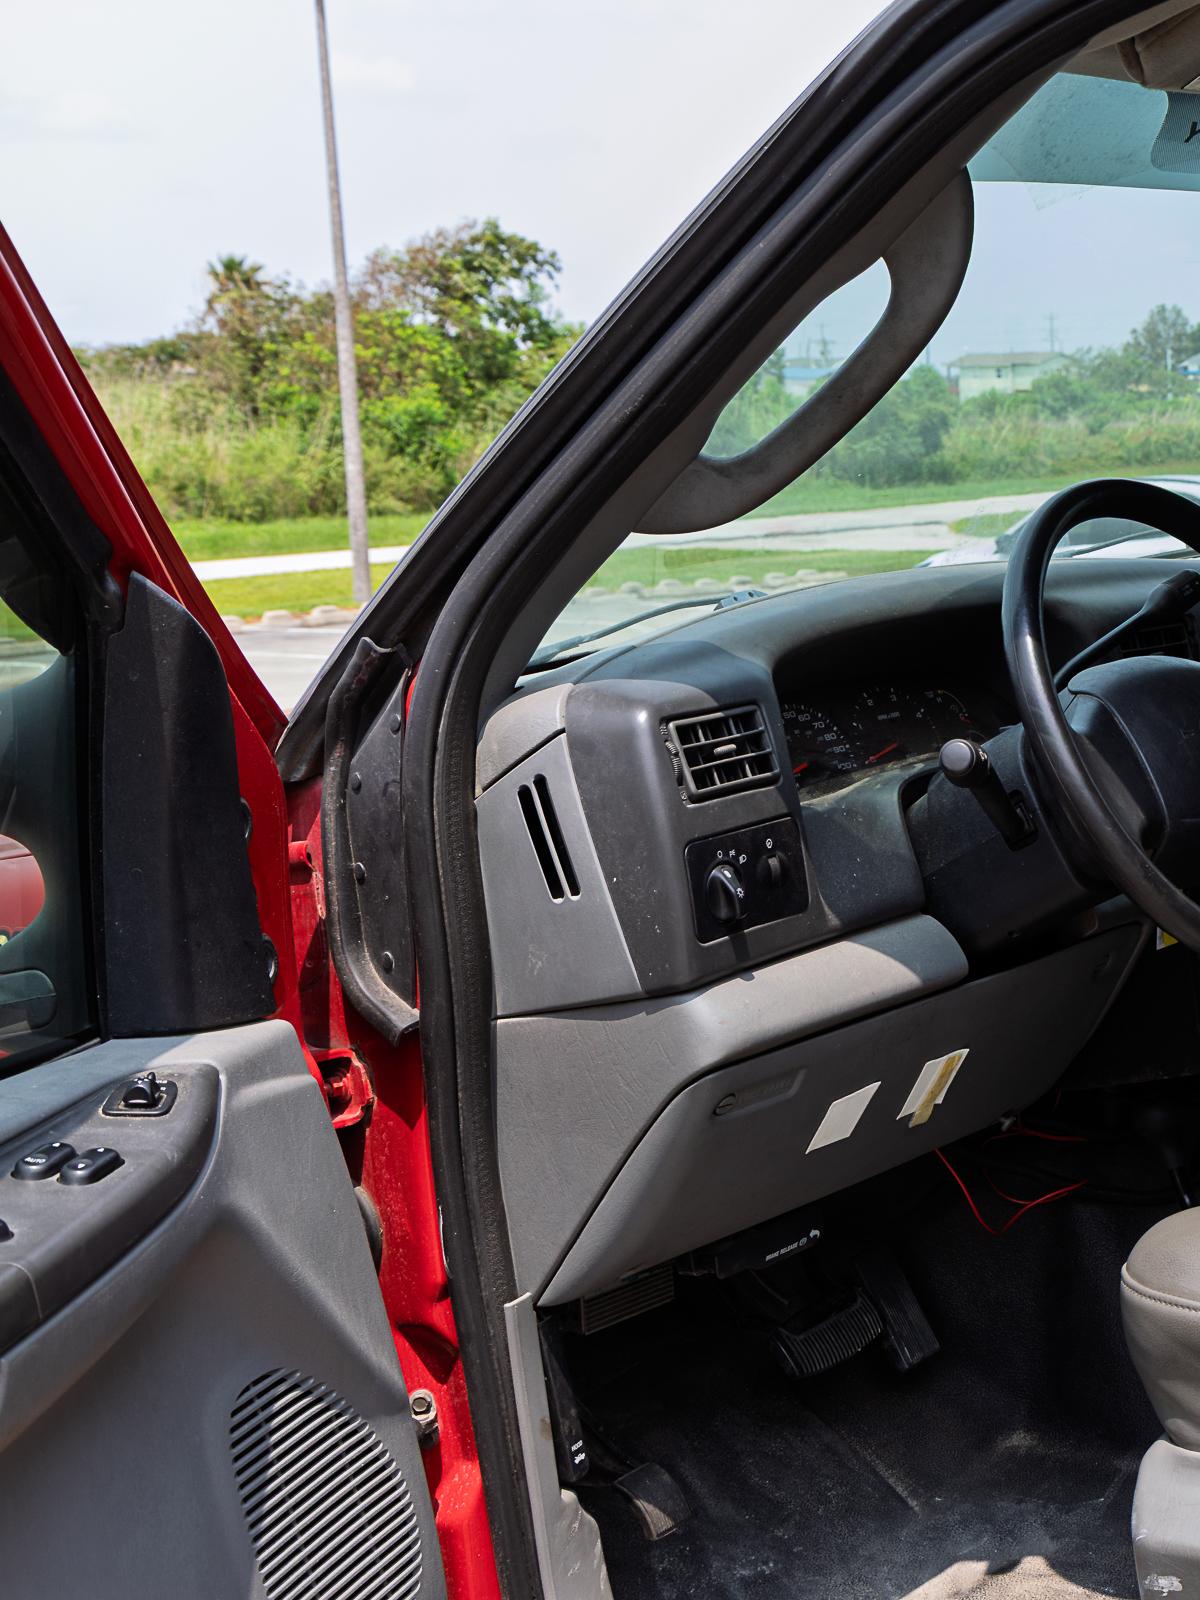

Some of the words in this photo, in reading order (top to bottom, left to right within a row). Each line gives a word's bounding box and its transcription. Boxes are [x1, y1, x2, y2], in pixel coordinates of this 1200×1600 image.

[783, 710, 797, 719] 50
[797, 713, 811, 722] 60
[811, 721, 825, 730] 70
[823, 732, 837, 741] 80
[24, 1156, 47, 1164] AUTO
[571, 1439, 583, 1452] HOOD
